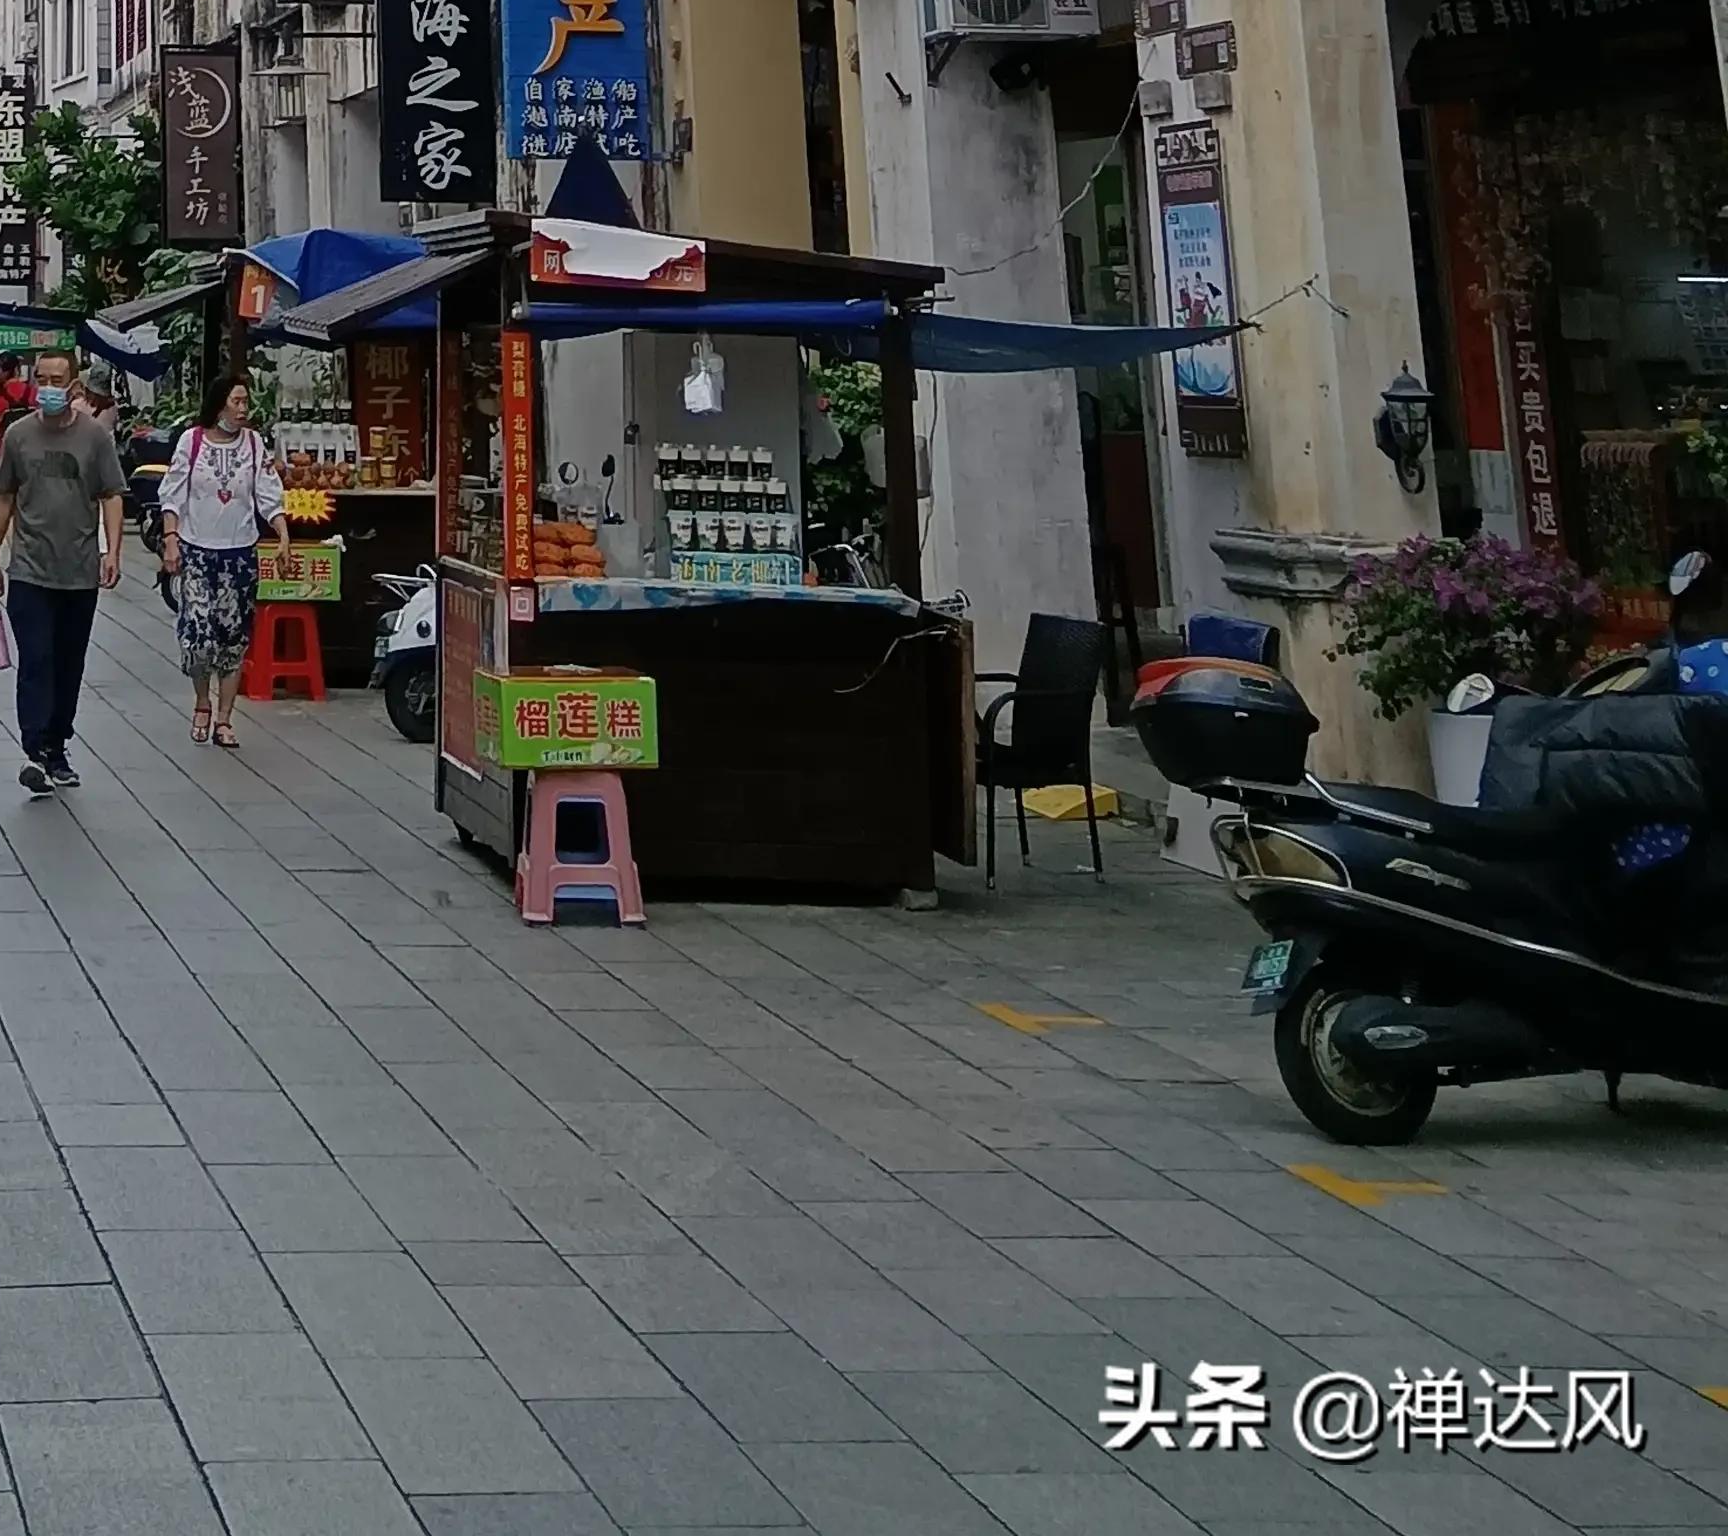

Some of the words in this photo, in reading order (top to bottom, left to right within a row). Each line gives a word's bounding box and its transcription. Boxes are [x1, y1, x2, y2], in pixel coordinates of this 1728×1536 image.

[185, 145, 212, 226] 手工坊
[514, 691, 645, 741] 榴莲糕
